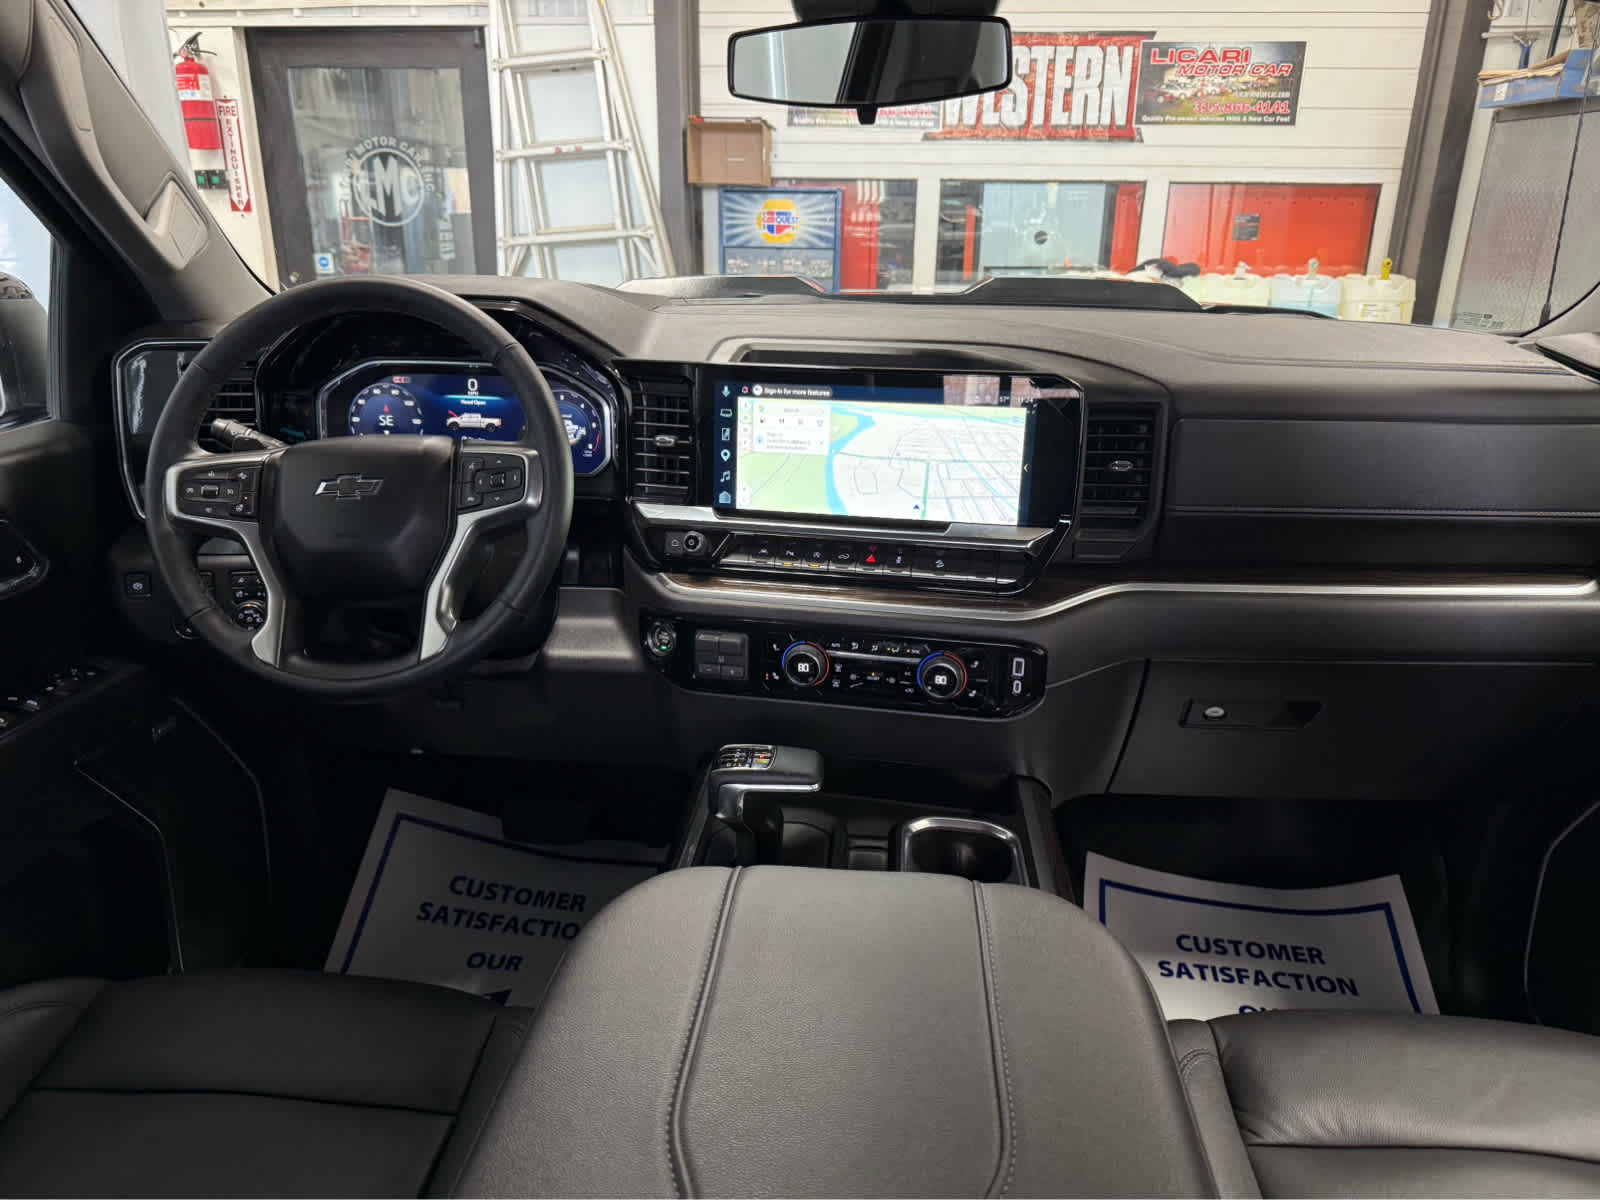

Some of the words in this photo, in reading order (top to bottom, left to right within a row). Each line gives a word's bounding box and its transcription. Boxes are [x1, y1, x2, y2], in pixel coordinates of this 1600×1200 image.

[1151, 48, 1251, 64] LICARI
[1177, 64, 1246, 77] MOTOR
[1251, 64, 1294, 77] CAR
[218, 105, 237, 117] FIRE
[354, 135, 398, 156] MOTOR
[467, 378, 479, 391] 0
[378, 415, 394, 427] SE
[448, 875, 587, 913] CUSTOMER
[416, 902, 581, 941] SATISFACTIO
[1175, 934, 1326, 965] CUSTOMER
[466, 952, 524, 972] OUR
[1158, 960, 1360, 997] SATISFACTION
